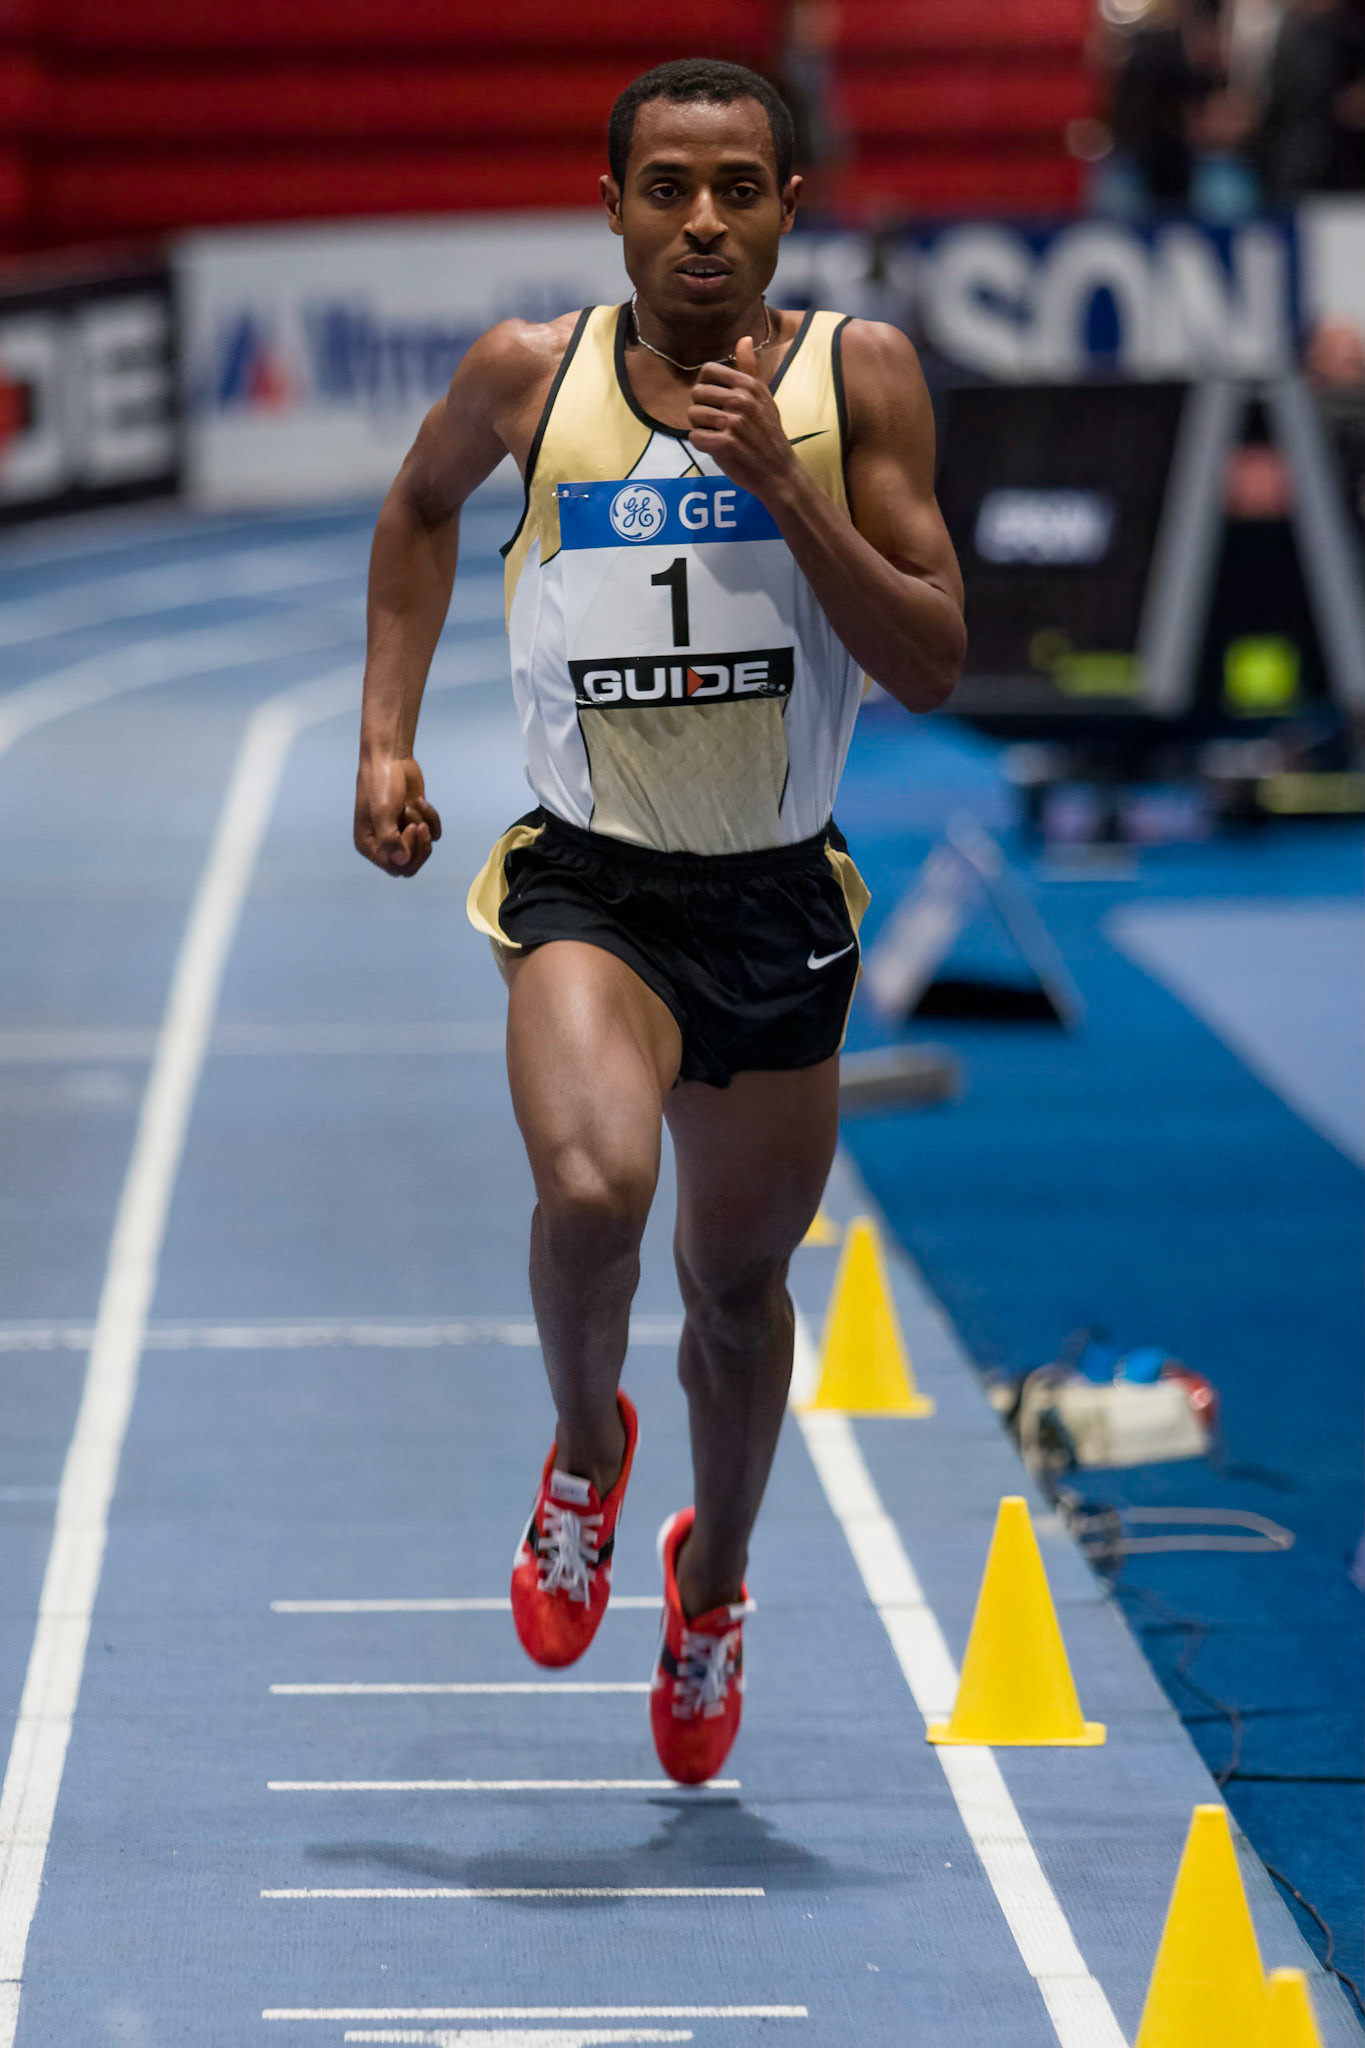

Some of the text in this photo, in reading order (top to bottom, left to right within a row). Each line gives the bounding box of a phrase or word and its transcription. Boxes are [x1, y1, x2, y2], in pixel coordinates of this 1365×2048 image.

[678, 490, 737, 530] GE
[651, 557, 690, 648] 1
[582, 660, 769, 702] GUIDE
